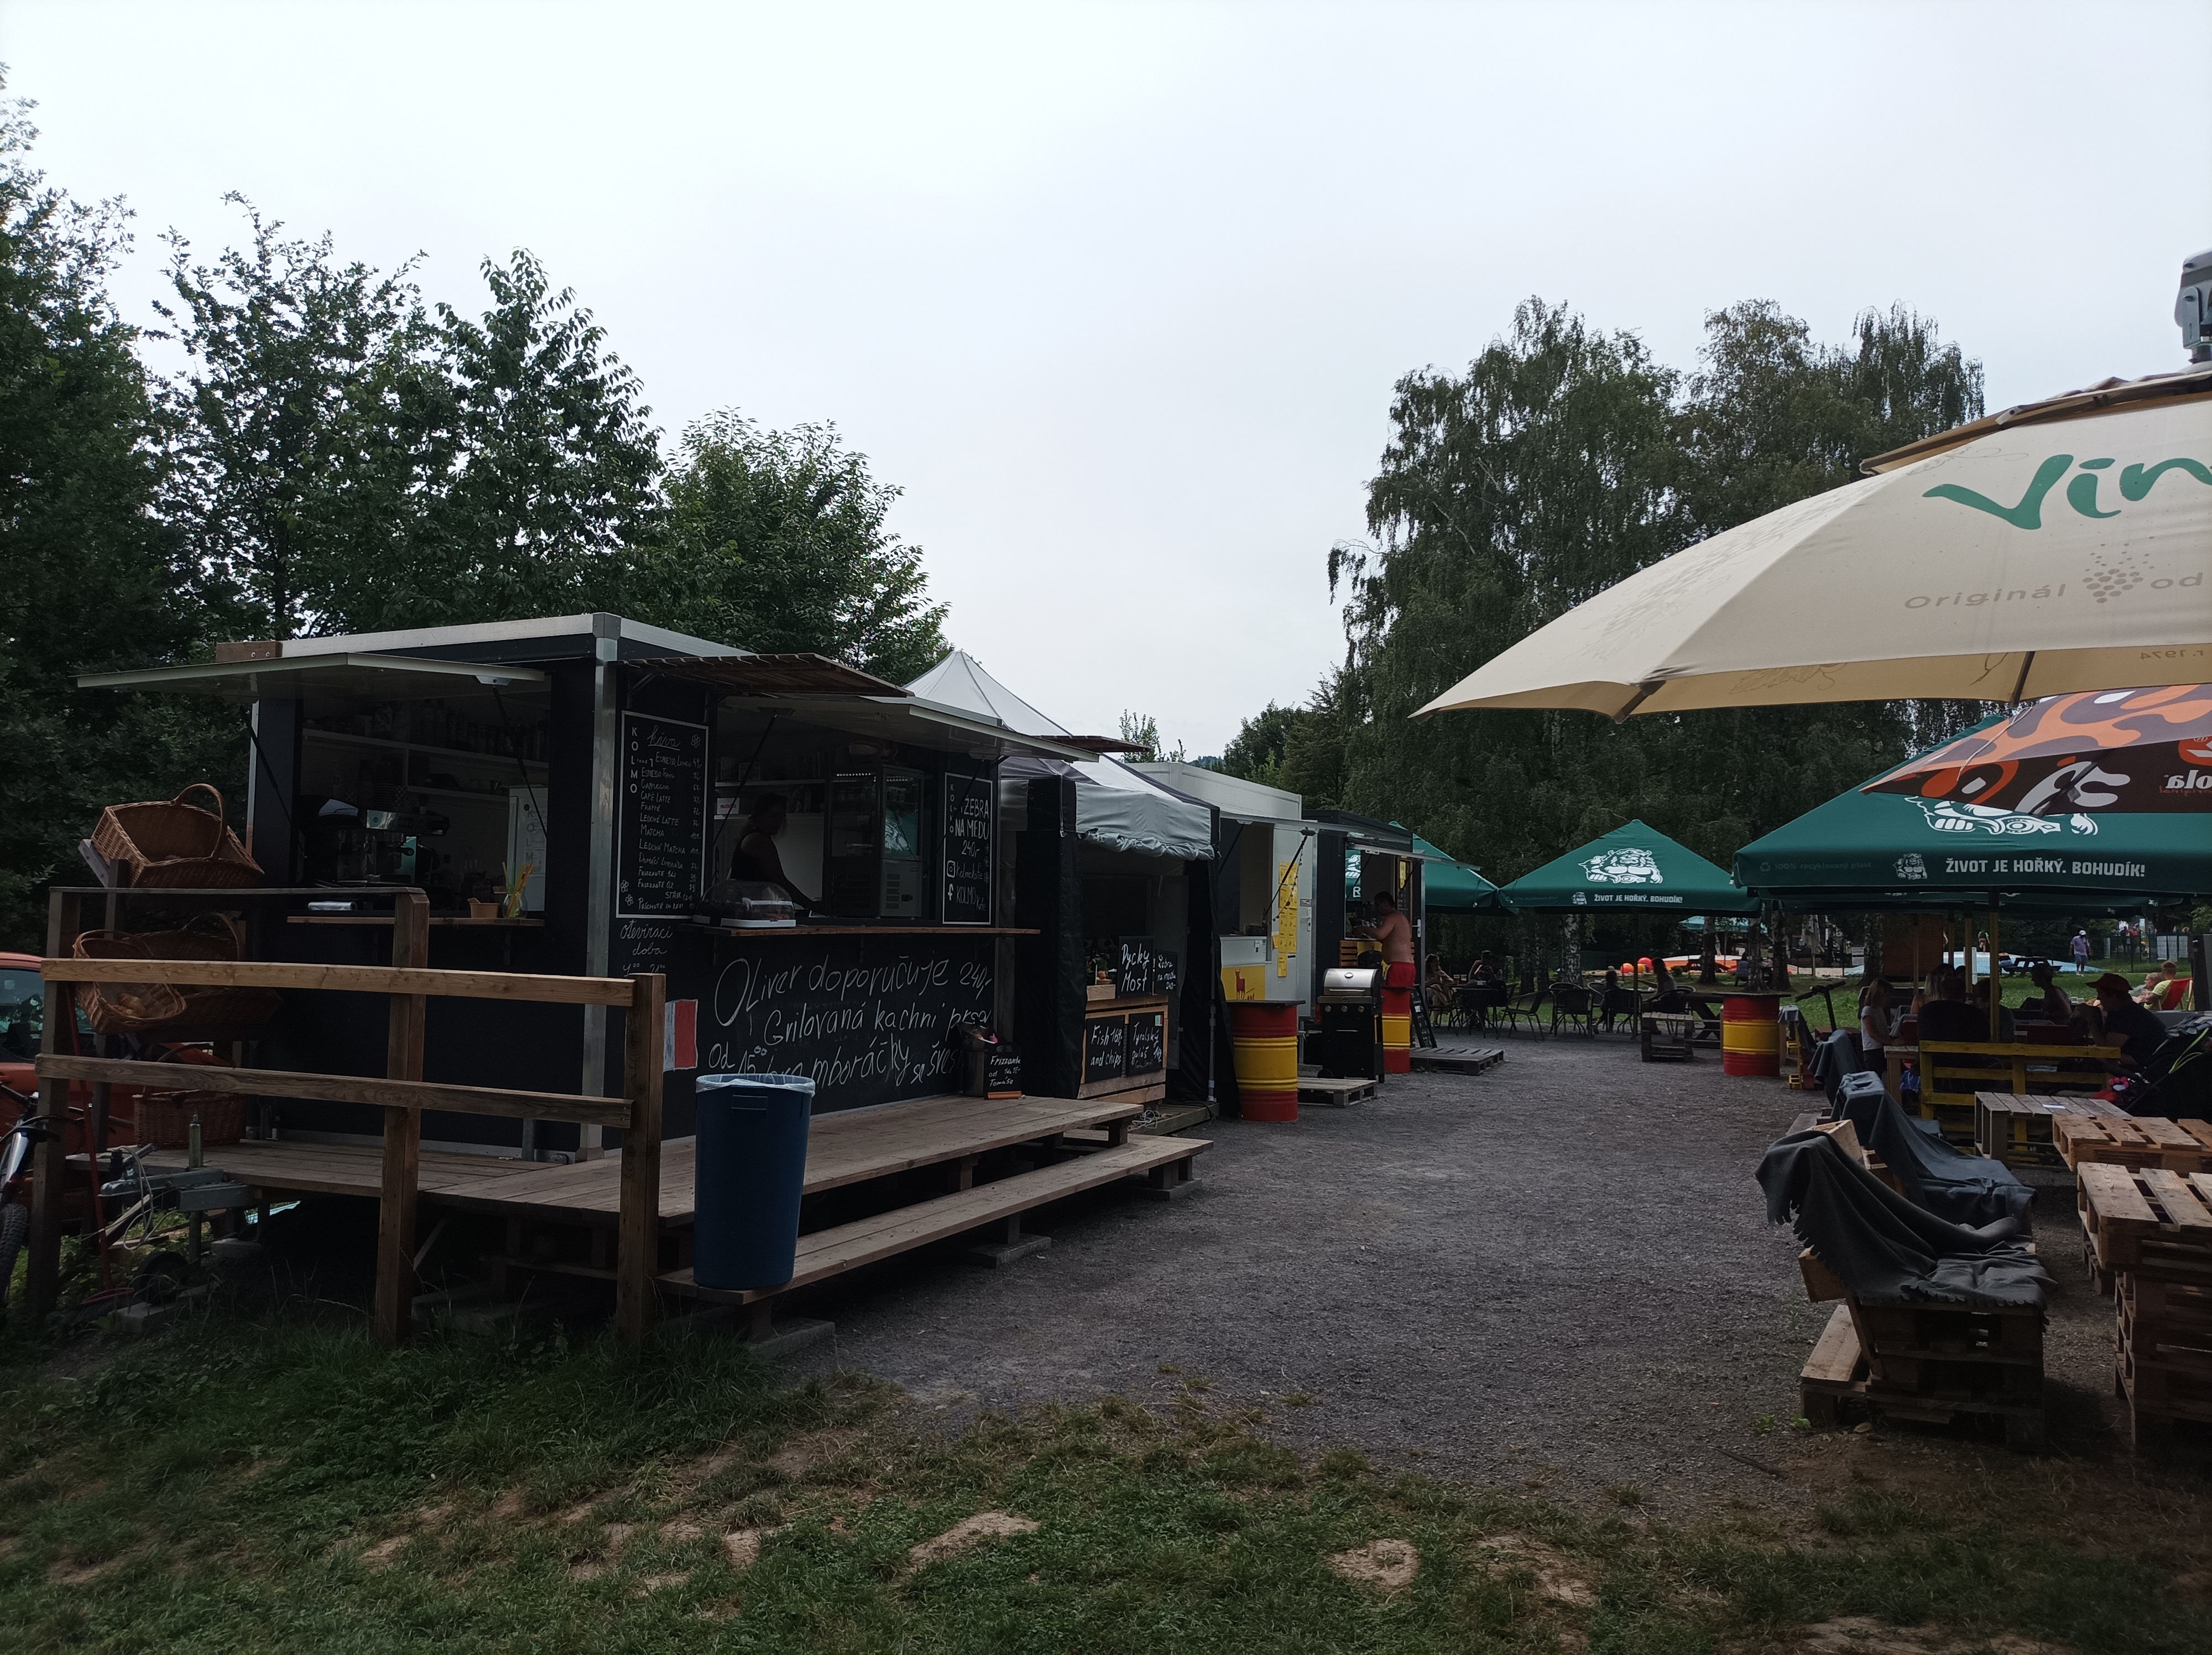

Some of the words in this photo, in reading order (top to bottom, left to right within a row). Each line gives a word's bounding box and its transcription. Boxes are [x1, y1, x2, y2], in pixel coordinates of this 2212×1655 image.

[1904, 583, 2066, 609] Originál
[2150, 572, 2203, 589] od
[646, 724, 681, 747] káva
[967, 819, 989, 840] MEDU
[1800, 861, 1849, 871] recyklovaný
[1851, 861, 1872, 870] plast
[1945, 857, 1989, 873] ŽIVOT
[1992, 860, 2008, 872] JE
[2013, 857, 2067, 873] HOŘKÝ.
[2072, 861, 2146, 877] BOHUDÍK!
[1594, 893, 1614, 902] ŽIVOT
[1624, 893, 1649, 902] HOŘKÝ.
[1650, 895, 1683, 903] BOHUDÍK!
[632, 941, 668, 956] doba
[1121, 968, 1147, 992] Most
[764, 1001, 866, 1045] Grilovaná
[874, 999, 946, 1032] kachní
[1091, 1024, 1109, 1046] Fish
[1090, 1050, 1105, 1066] and
